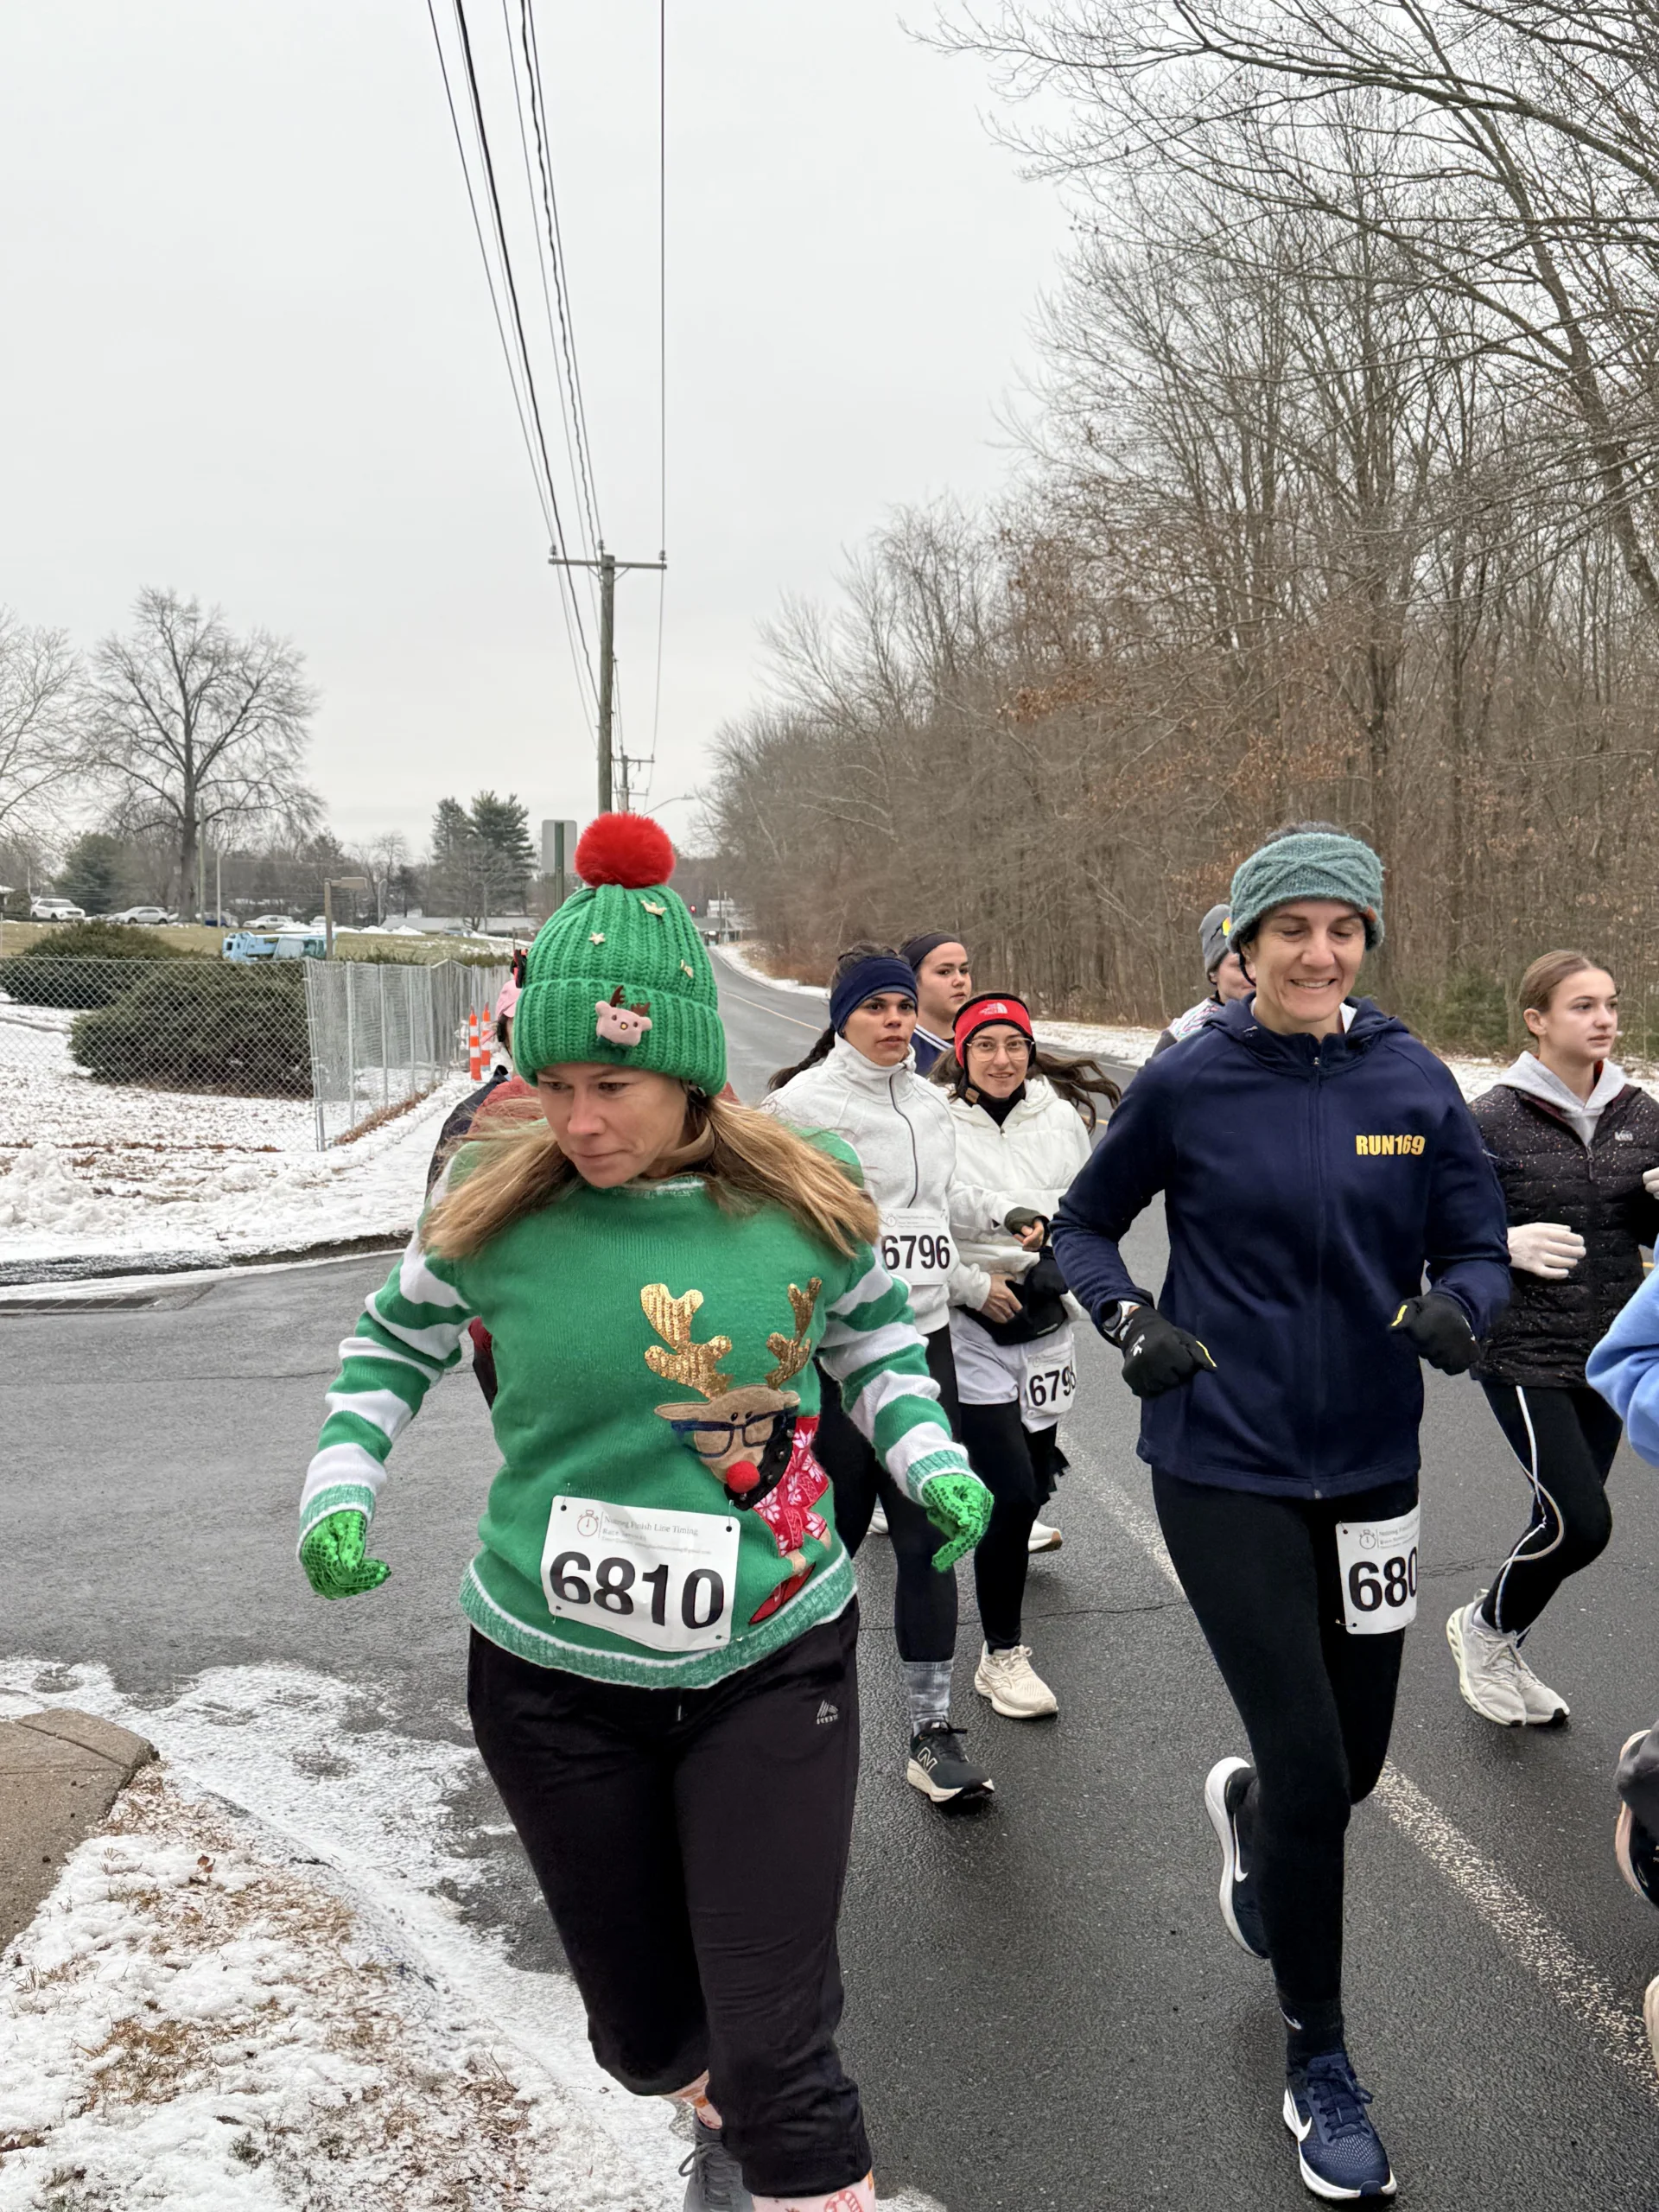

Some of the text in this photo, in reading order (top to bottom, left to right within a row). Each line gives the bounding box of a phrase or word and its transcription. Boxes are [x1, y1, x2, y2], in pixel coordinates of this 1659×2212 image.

[1356, 1135, 1426, 1156] RUN169
[881, 1234, 950, 1271] 6796
[654, 1523, 671, 1533] Line
[671, 1525, 699, 1537] Timing
[550, 1550, 724, 1630] 6810
